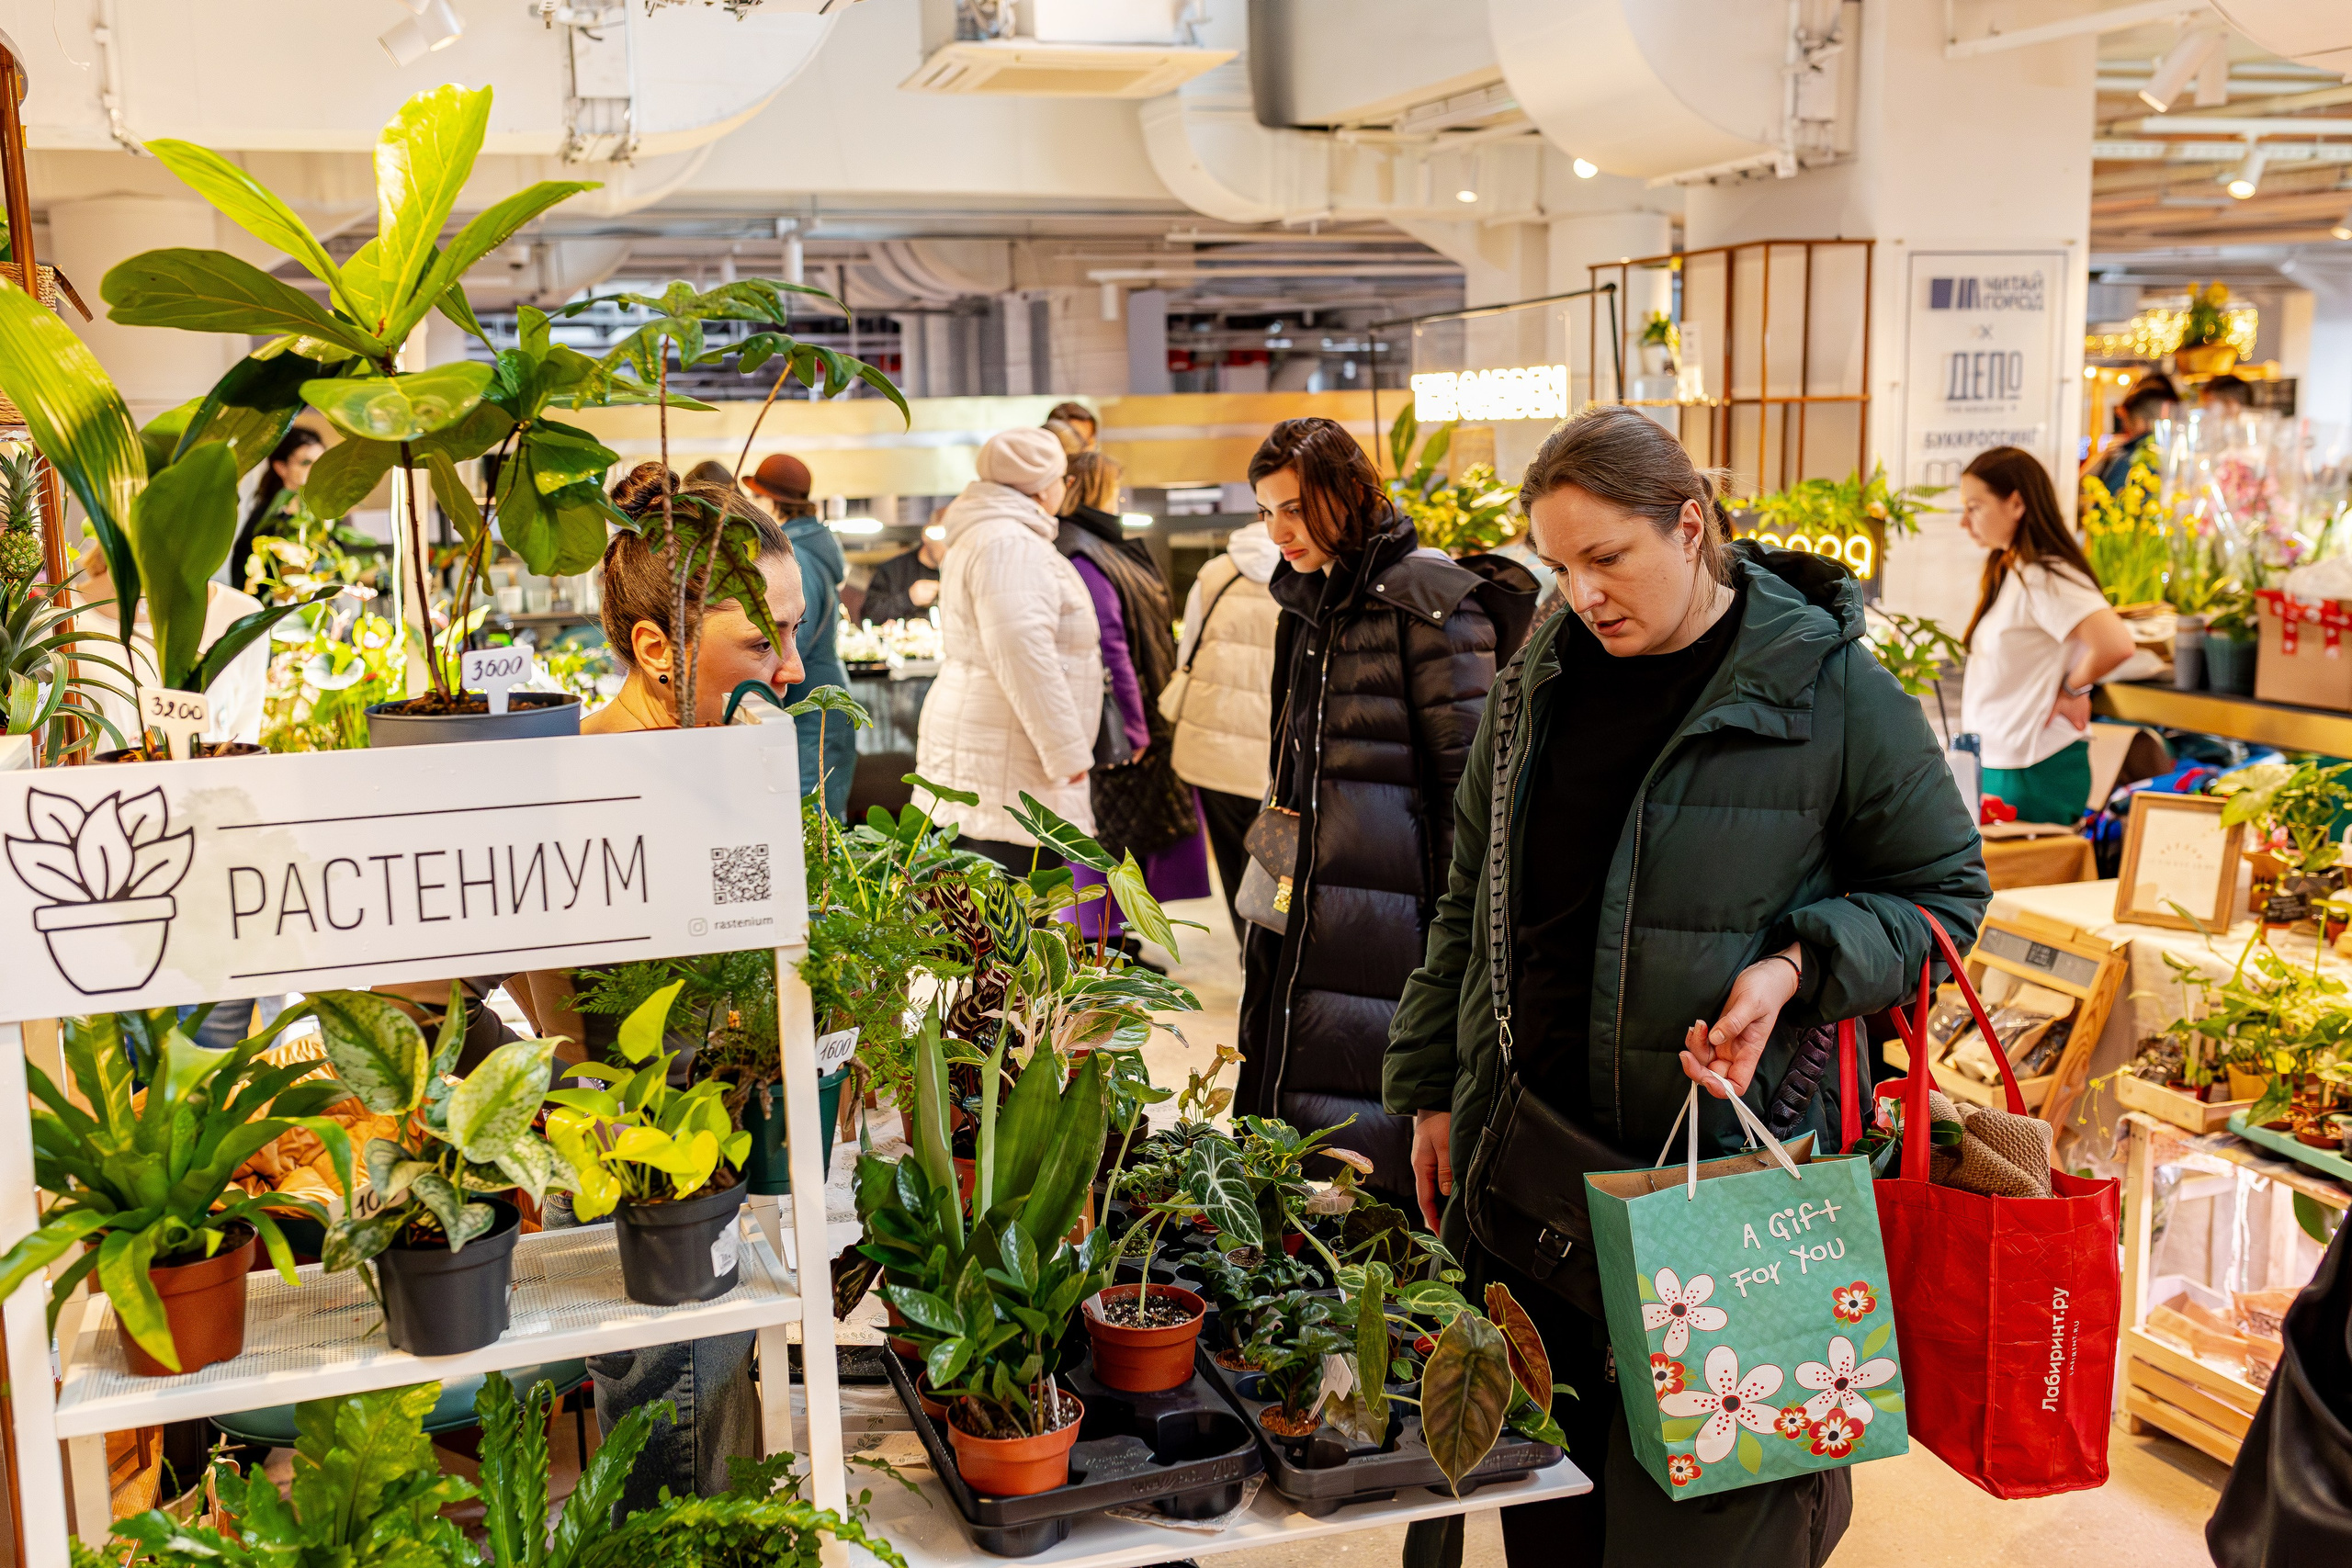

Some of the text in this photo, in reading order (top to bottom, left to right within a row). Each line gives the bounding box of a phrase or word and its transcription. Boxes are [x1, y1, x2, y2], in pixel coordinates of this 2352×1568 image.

[1984, 271, 2044, 290] ЧИТАЙ
[1984, 293, 2044, 310] ГОРОД
[1946, 350, 2023, 400] ДЕПО
[471, 656, 523, 681] 3600
[152, 696, 203, 720] 3200
[229, 834, 649, 941] РАСТЕНИУМ
[714, 917, 774, 931] rastenium
[820, 1037, 853, 1061] 1600
[1743, 1223, 1761, 1250] A
[2041, 1286, 2070, 1412] Лабиринт.ру
